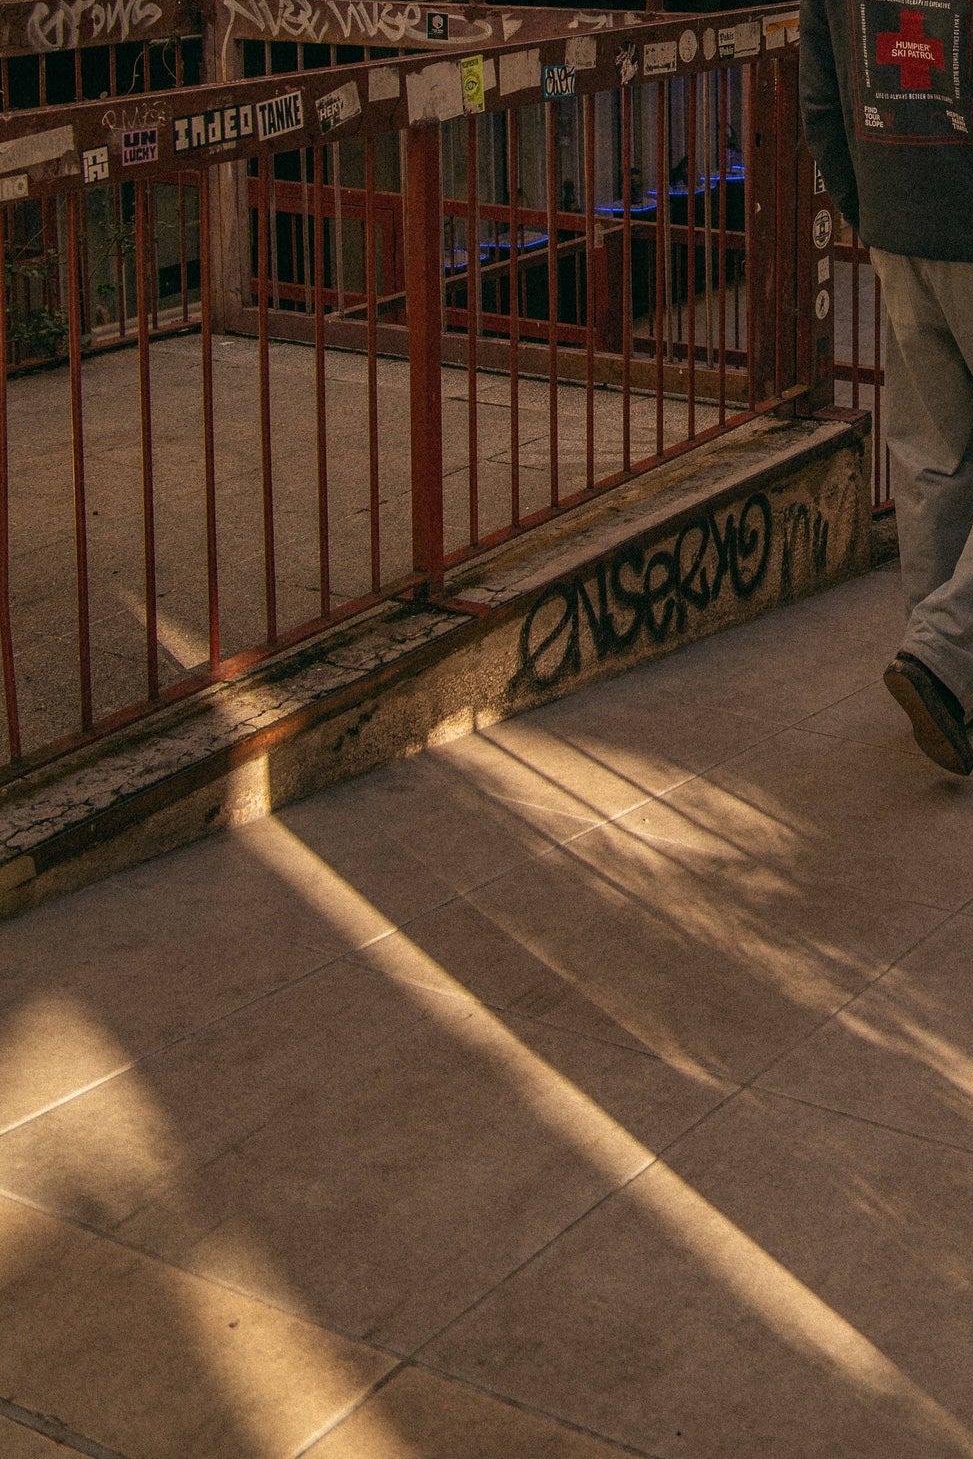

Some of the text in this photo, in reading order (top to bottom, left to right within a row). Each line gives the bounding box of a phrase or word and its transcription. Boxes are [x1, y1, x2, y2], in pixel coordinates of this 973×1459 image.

[908, 50, 935, 60] PATROL
[260, 94, 302, 136] TANKE
[864, 113, 880, 121] YOUR
[865, 119, 884, 128] SLOPE
[124, 130, 157, 147] UN
